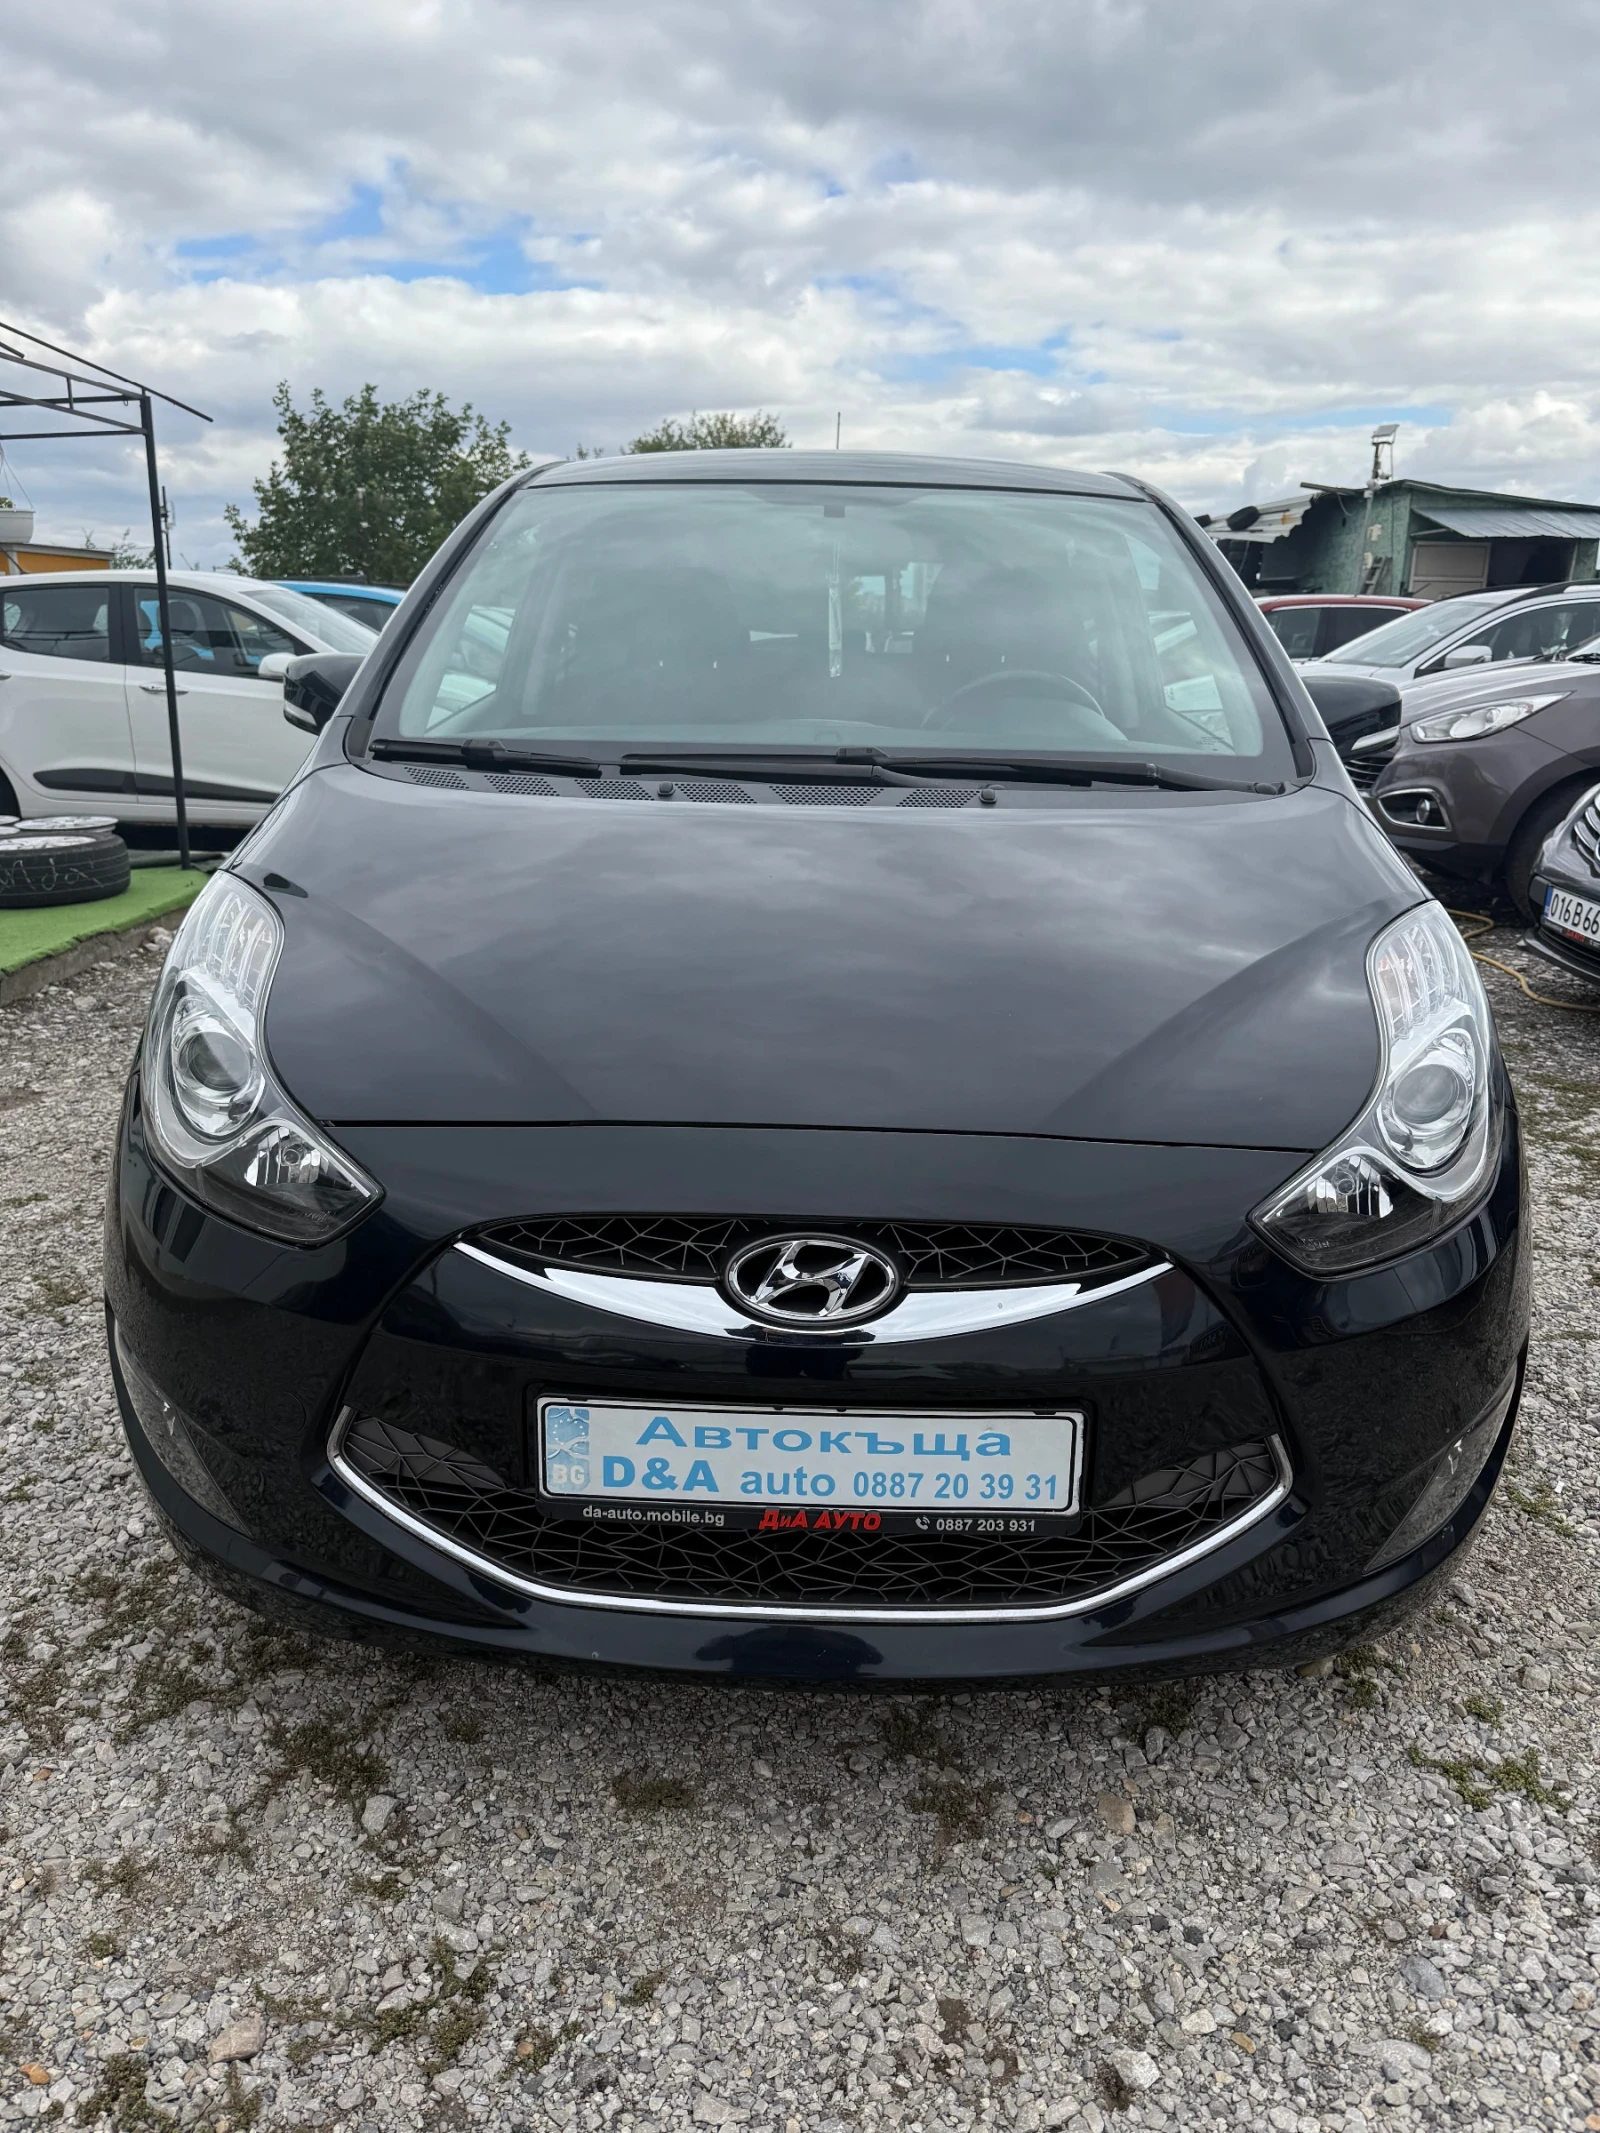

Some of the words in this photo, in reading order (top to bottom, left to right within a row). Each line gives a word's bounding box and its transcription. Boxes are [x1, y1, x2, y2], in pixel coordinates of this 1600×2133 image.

[635, 1416, 1012, 1461] Автокъща
[552, 1464, 585, 1485] BG
[602, 1455, 720, 1493] D&A
[740, 1465, 836, 1497] auto
[853, 1471, 924, 1498] 0887
[934, 1472, 969, 1500] 20
[980, 1473, 1014, 1500] 39
[1024, 1473, 1057, 1500] 31
[582, 1504, 725, 1527] da-auto.mobile.bg
[813, 1510, 882, 1531] АУТО
[936, 1518, 971, 1532] 0887
[977, 1519, 1004, 1532] 203
[1009, 1519, 1036, 1532] 931
